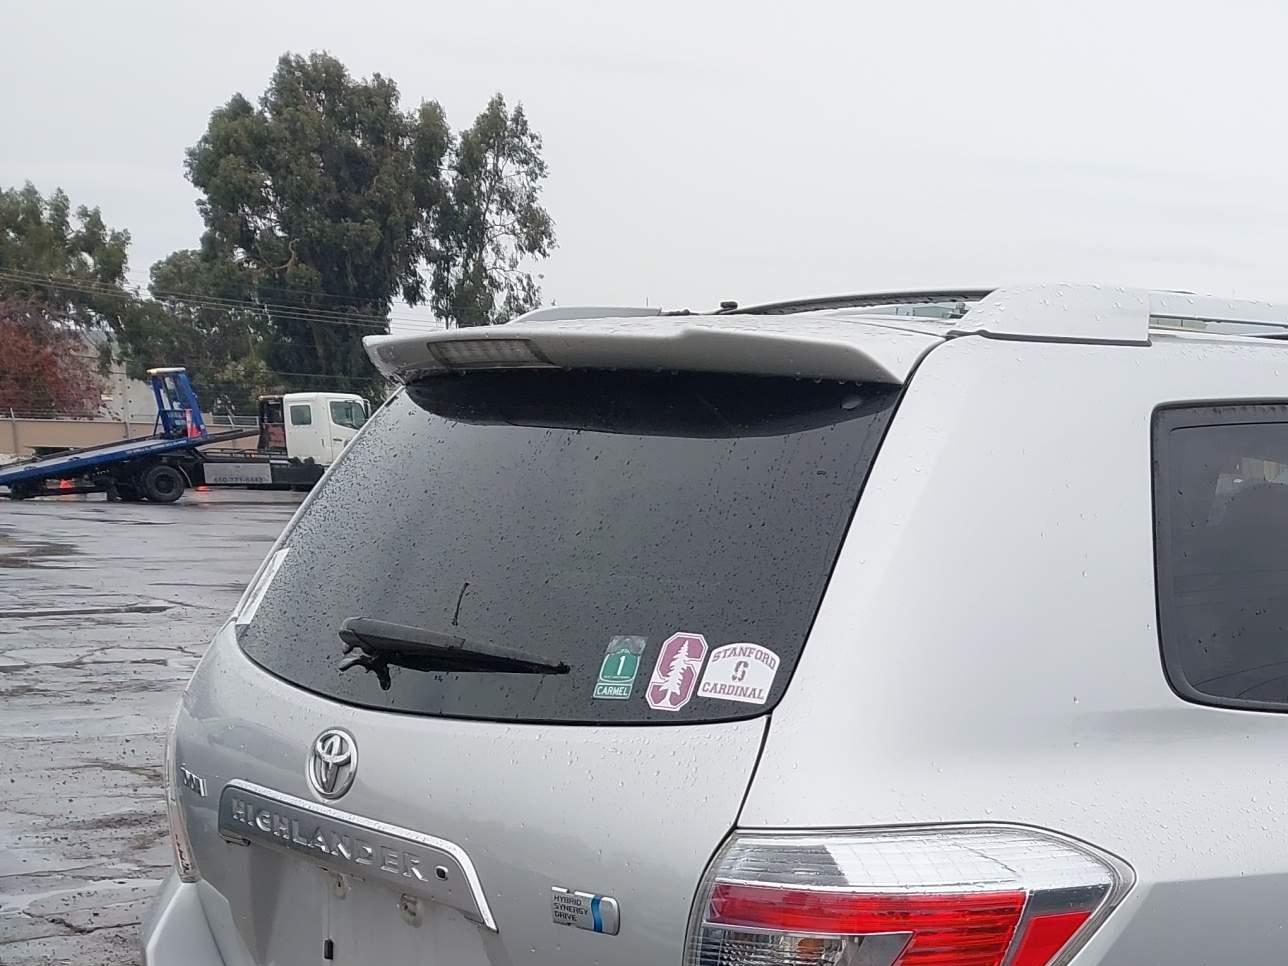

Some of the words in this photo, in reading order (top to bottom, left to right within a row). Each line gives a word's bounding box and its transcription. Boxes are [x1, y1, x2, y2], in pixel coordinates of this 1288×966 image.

[616, 655, 626, 676] 1
[712, 646, 777, 670] STANFORD
[596, 686, 629, 697] CARMEL
[702, 681, 765, 700] CARDINAL
[231, 796, 429, 882] HIGHLANDER
[553, 893, 582, 906] HYBRID
[553, 902, 588, 916] SYNERGY
[554, 910, 578, 922] DRIVE
